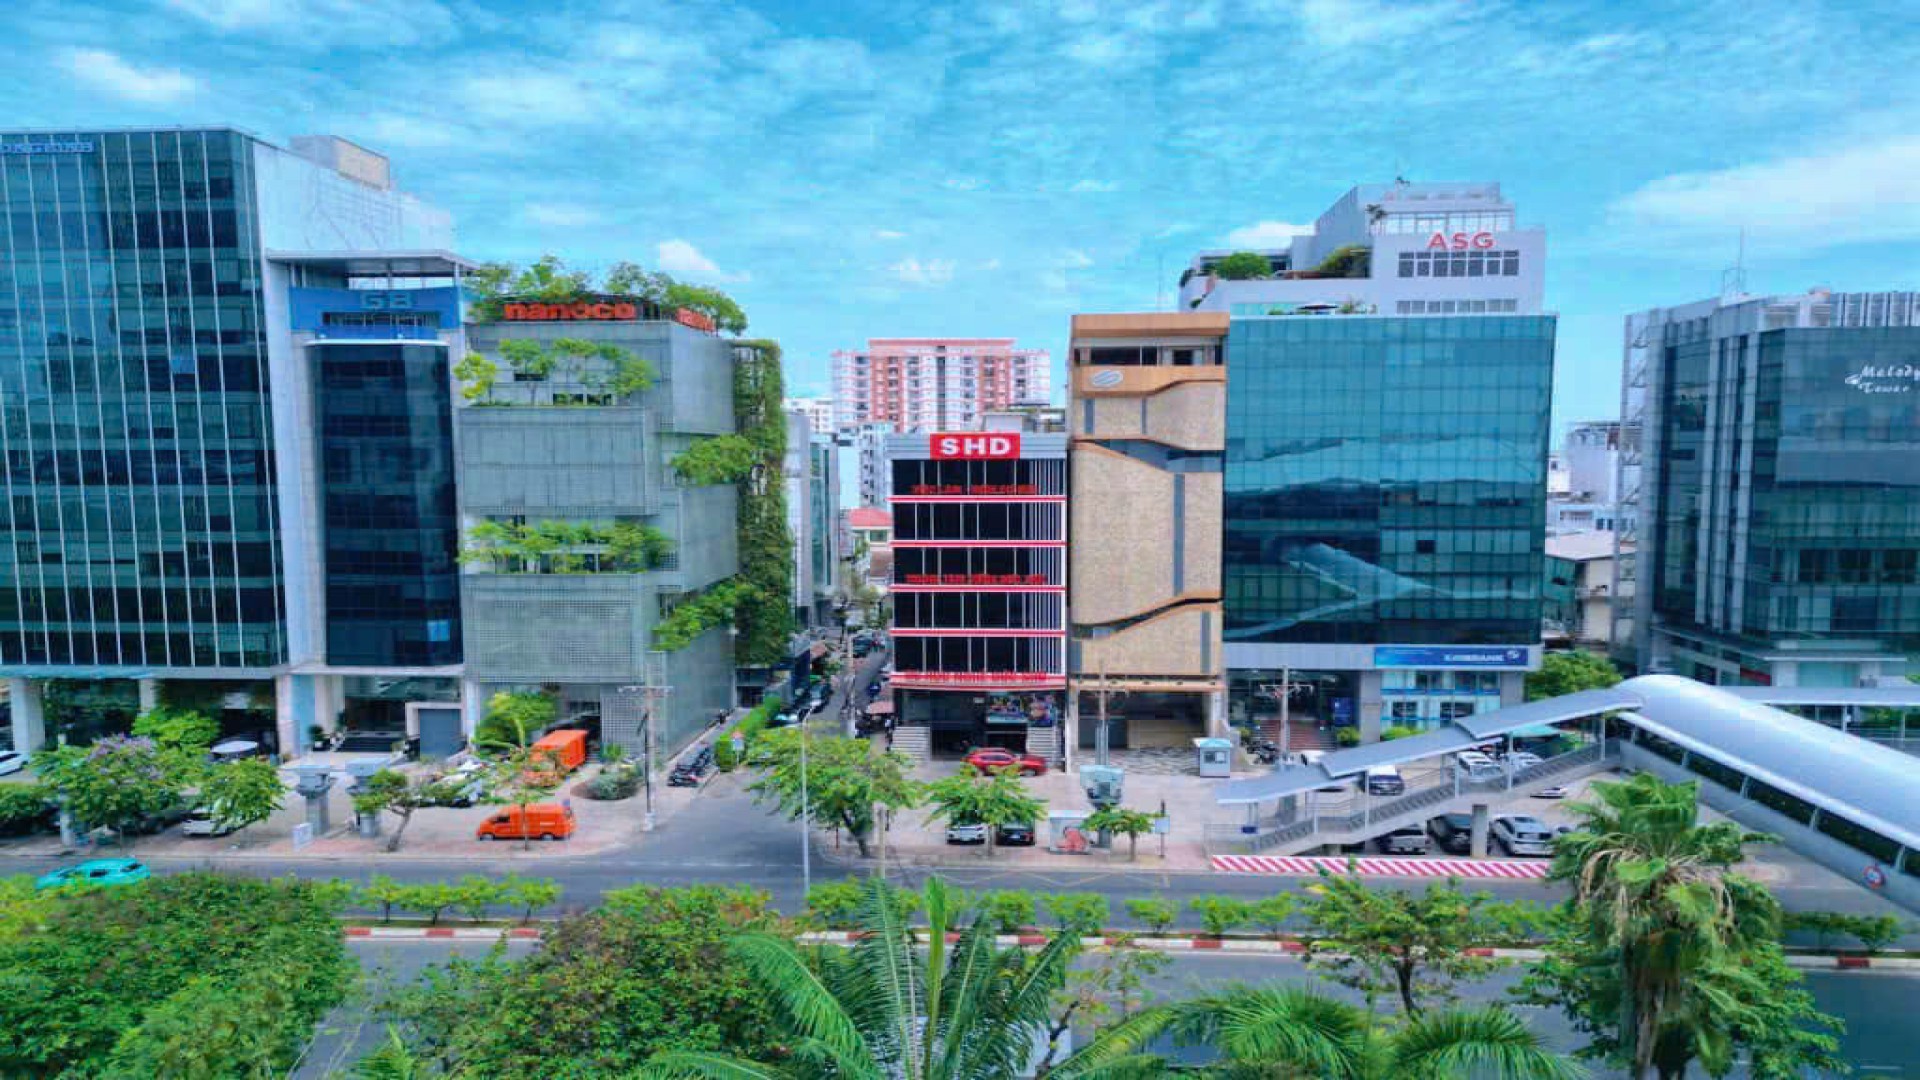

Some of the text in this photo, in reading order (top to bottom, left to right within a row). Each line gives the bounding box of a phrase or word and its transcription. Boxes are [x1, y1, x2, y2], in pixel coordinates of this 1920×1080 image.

[1426, 231, 1495, 249] ASG
[504, 303, 636, 320] nanoco
[941, 437, 1012, 456] SHD
